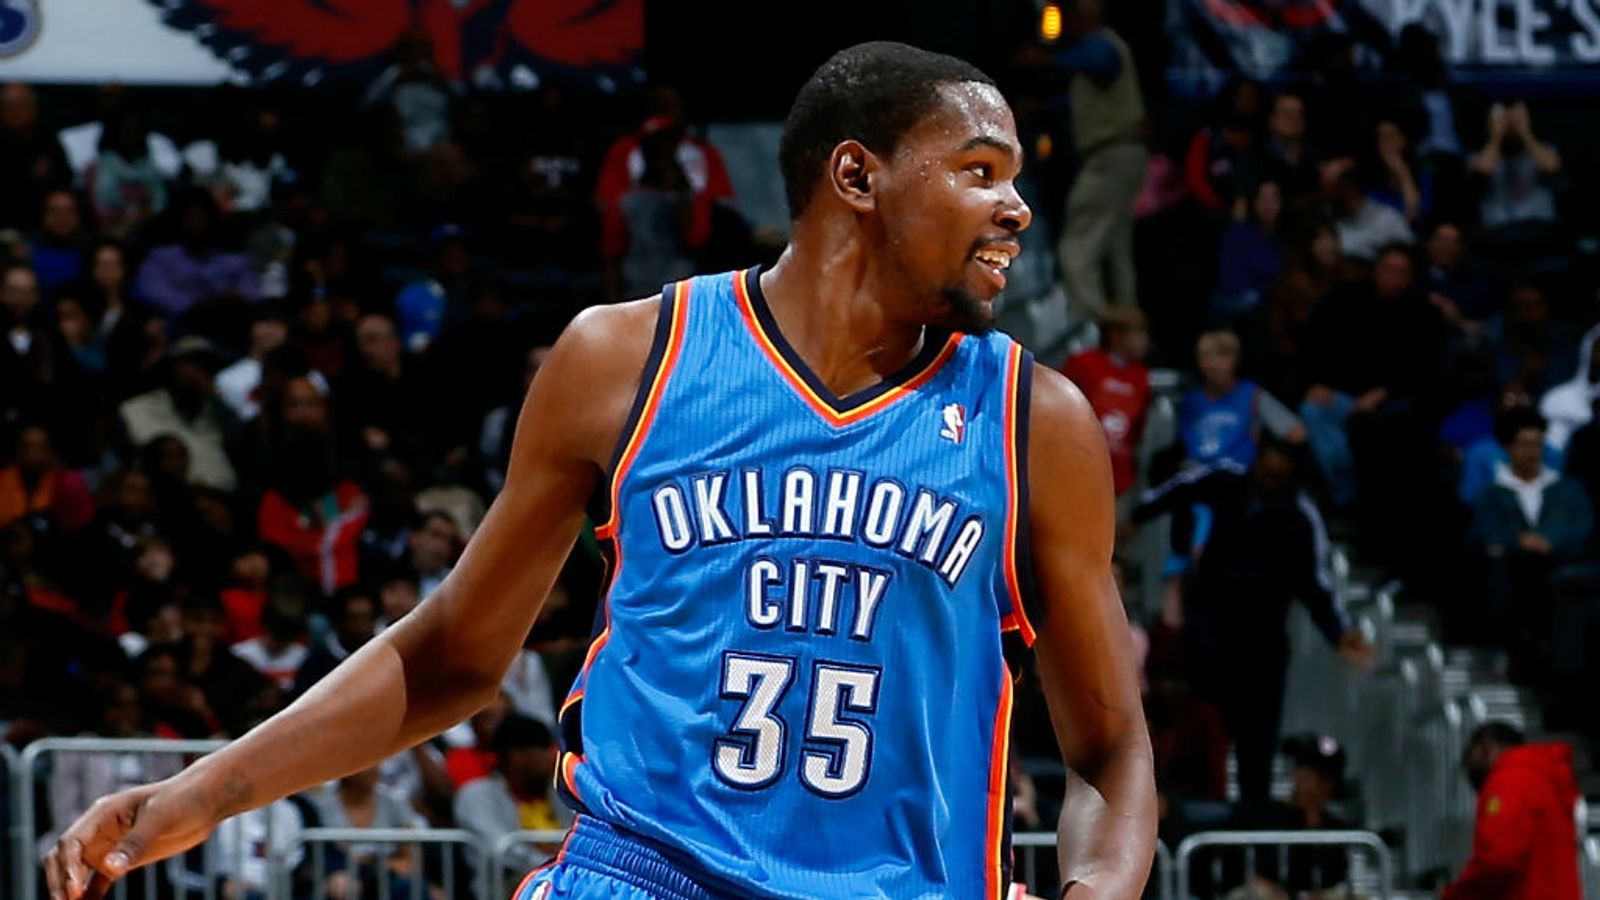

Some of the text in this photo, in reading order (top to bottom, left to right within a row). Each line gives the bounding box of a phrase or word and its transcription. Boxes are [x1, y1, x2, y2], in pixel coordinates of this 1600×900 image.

[653, 466, 985, 589] OKLAHOMA
[747, 556, 892, 641] CITY
[713, 651, 882, 799] 35
